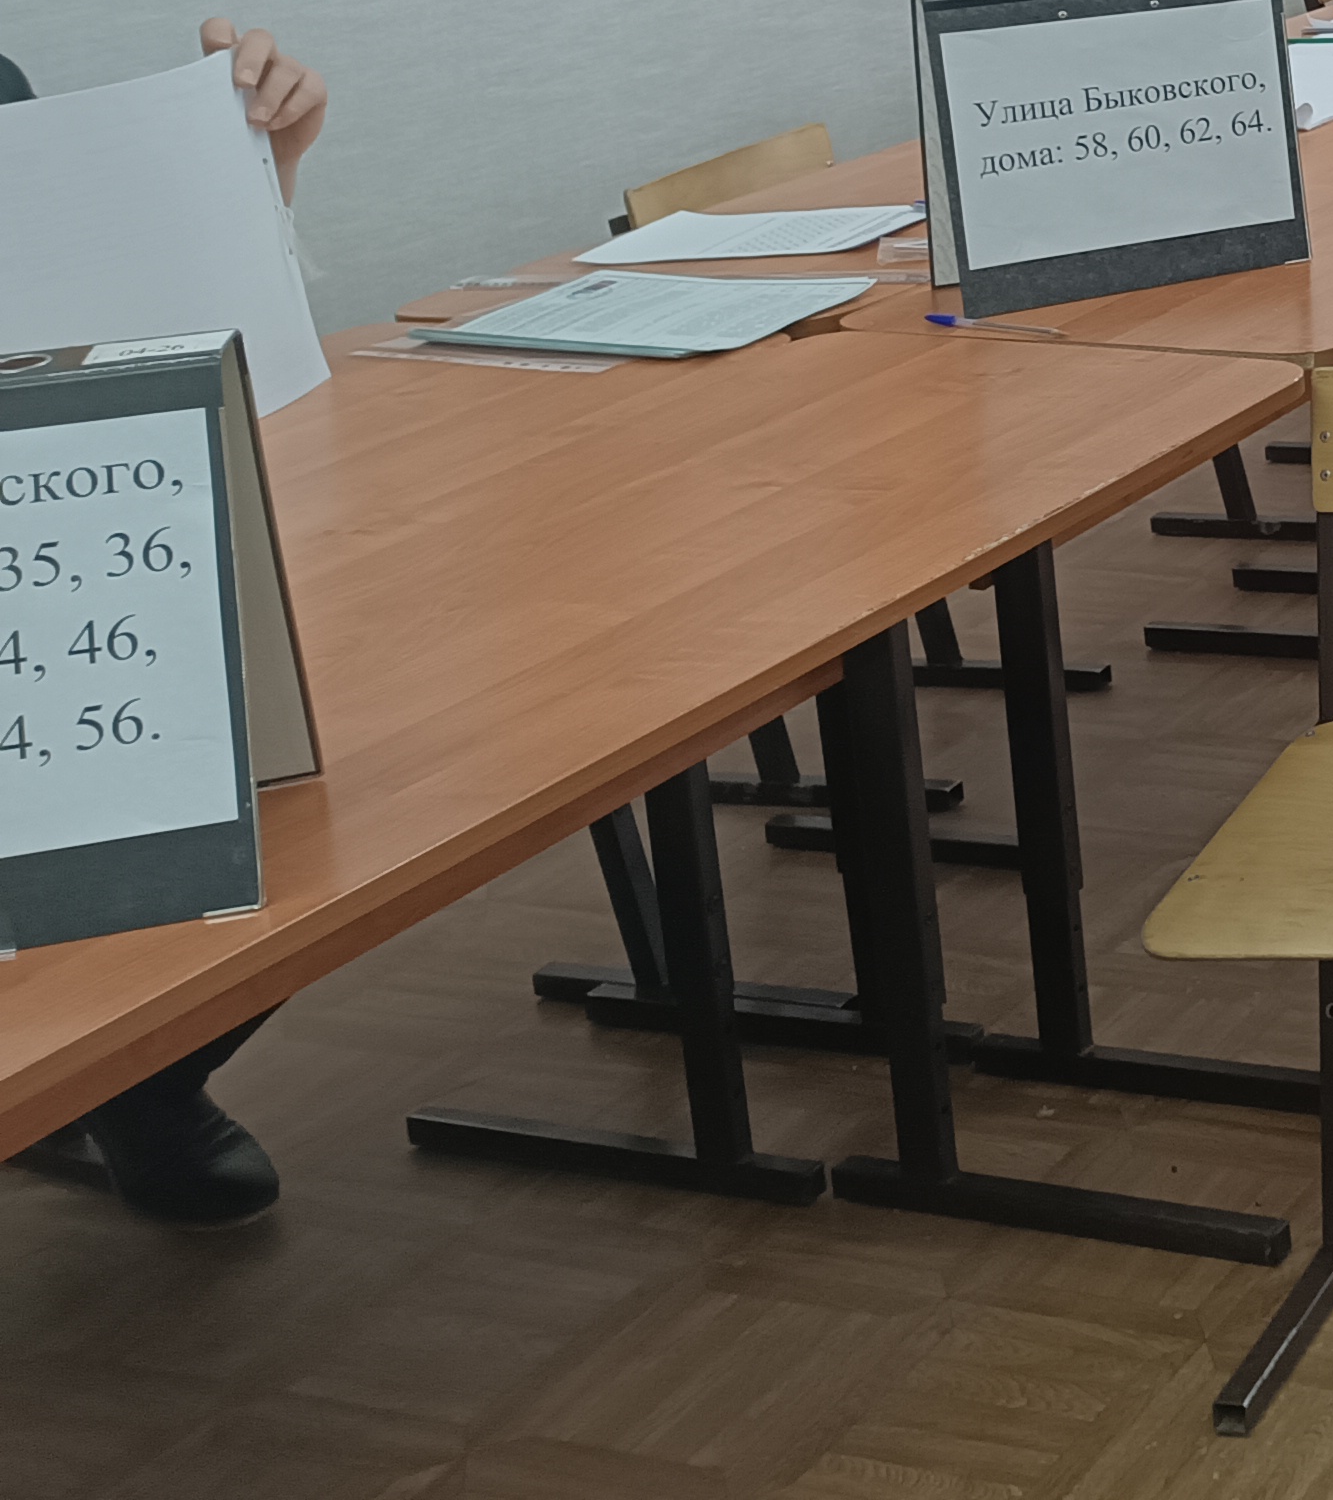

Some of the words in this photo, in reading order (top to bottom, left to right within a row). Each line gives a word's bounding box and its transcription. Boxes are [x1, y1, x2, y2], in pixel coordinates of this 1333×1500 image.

[973, 97, 1074, 128] Улица
[1082, 71, 1267, 113] Быковского,
[980, 146, 1064, 178] дома:
[1074, 132, 1118, 162] 58,
[1127, 124, 1171, 153] 60,
[1179, 117, 1222, 145] 62,
[1231, 109, 1272, 138] 64.
[0, 540, 84, 593] 35,
[104, 525, 193, 580] 36,
[67, 613, 158, 667] 46,
[74, 697, 161, 752] 56.
